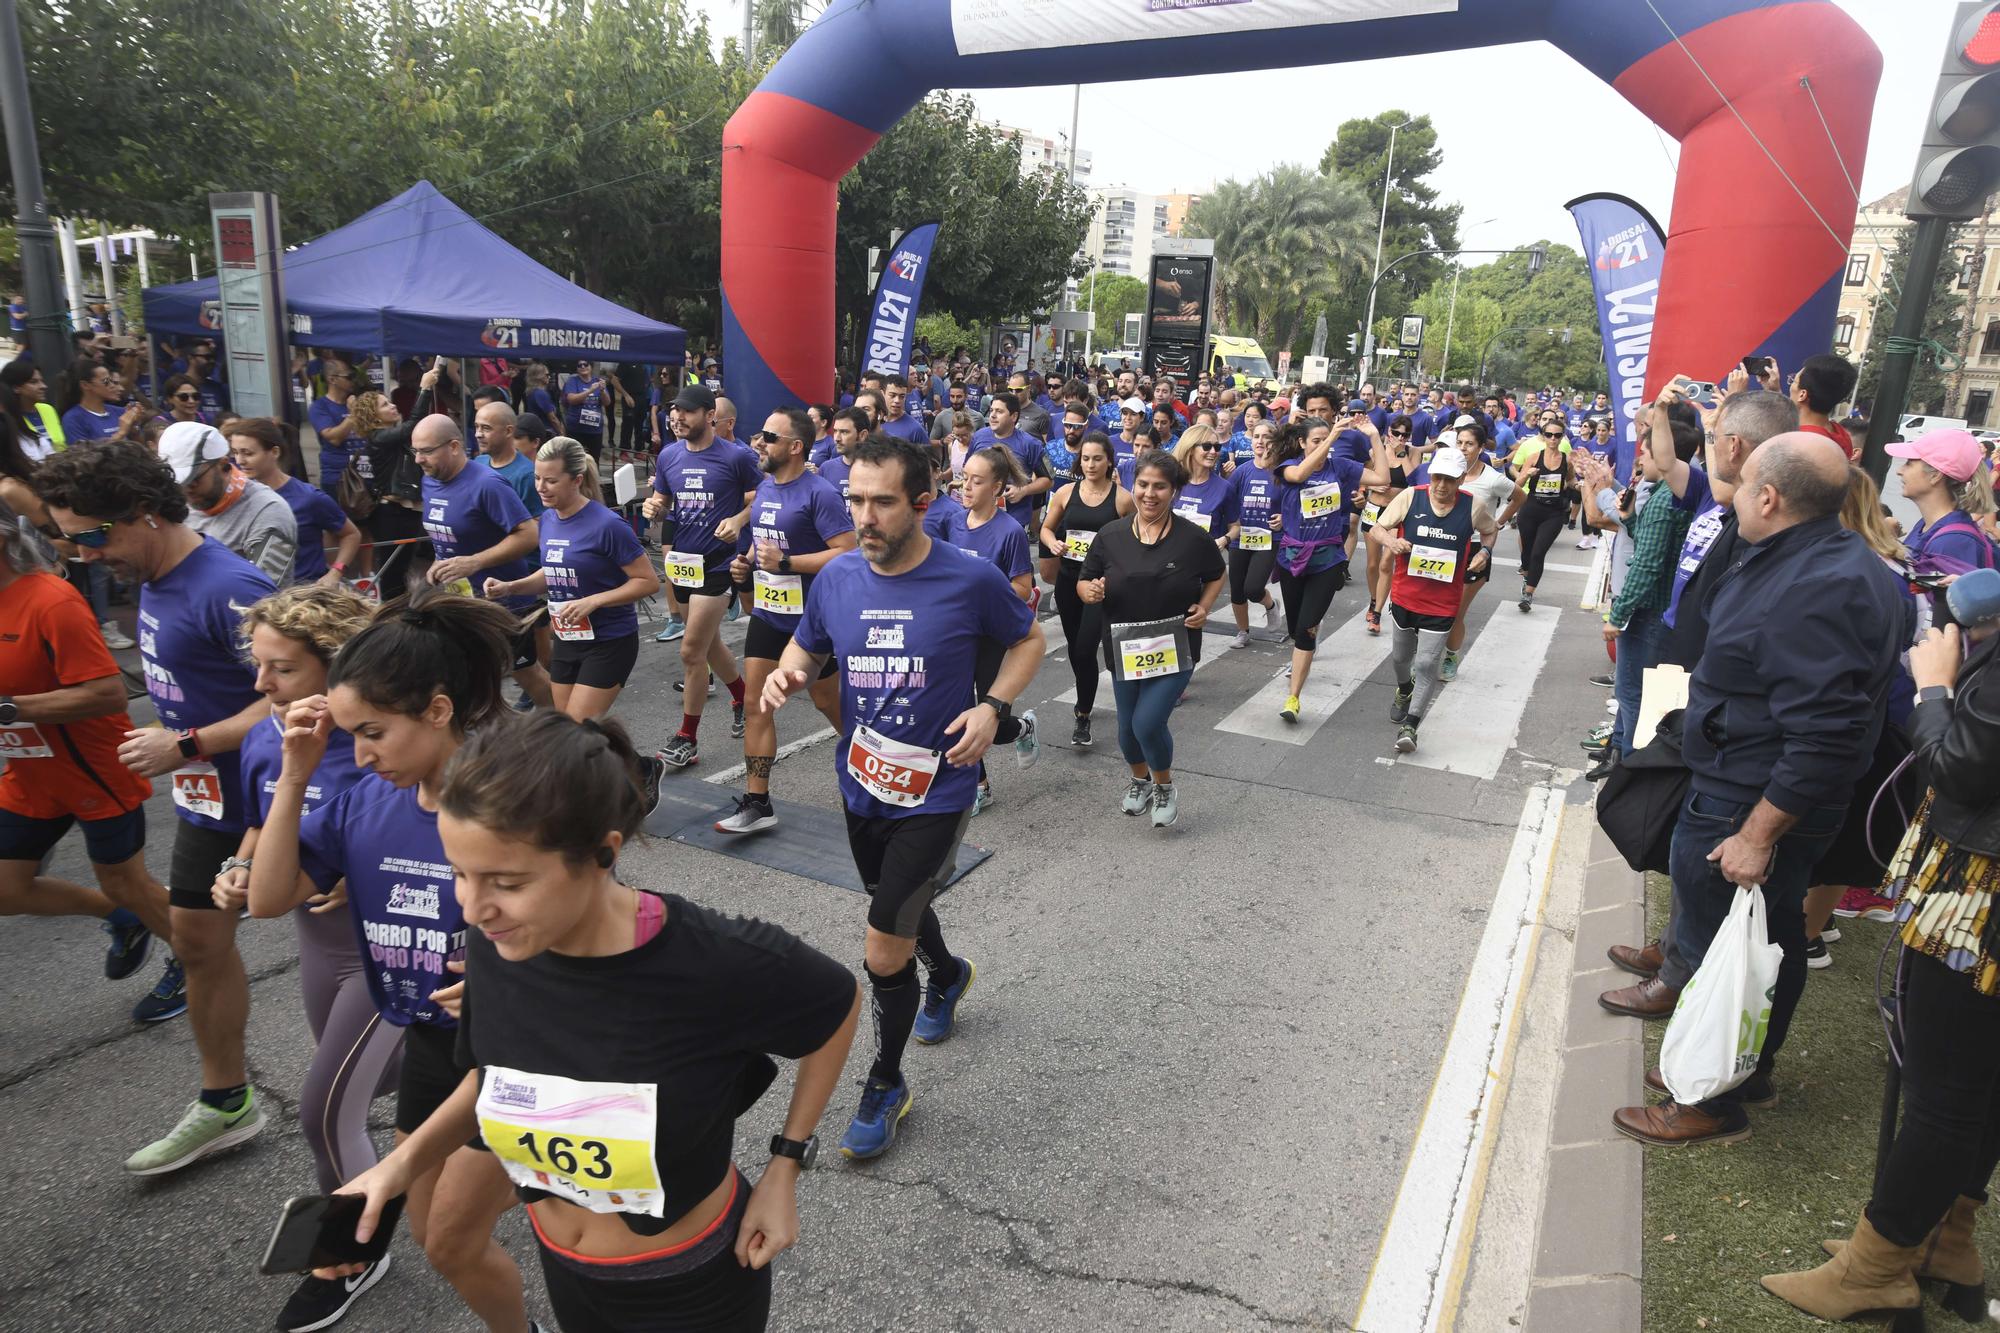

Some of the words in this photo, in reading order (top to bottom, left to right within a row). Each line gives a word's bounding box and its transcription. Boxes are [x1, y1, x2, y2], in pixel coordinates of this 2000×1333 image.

[1608, 222, 1648, 248] DORSAL
[1616, 235, 1649, 269] 21
[900, 260, 918, 282] 21
[496, 327, 518, 348] 21
[530, 328, 621, 350] DORSAL21.COM
[1311, 496, 1333, 508] 278
[1429, 527, 1443, 535] pan
[1429, 533, 1457, 541] moreno
[674, 565, 695, 577] 350
[1419, 559, 1445, 571] 277
[764, 587, 788, 602] 221
[847, 656, 885, 672] CORRO
[887, 656, 909, 673] POR
[912, 657, 924, 672] TI
[1135, 652, 1165, 667] 292
[848, 672, 883, 688] CORRO
[885, 673, 905, 688] POR
[865, 755, 912, 788] 054
[405, 888, 439, 900] CARRERA
[416, 927, 447, 954] POR
[412, 949, 443, 976] POR
[518, 1132, 612, 1180] 163
